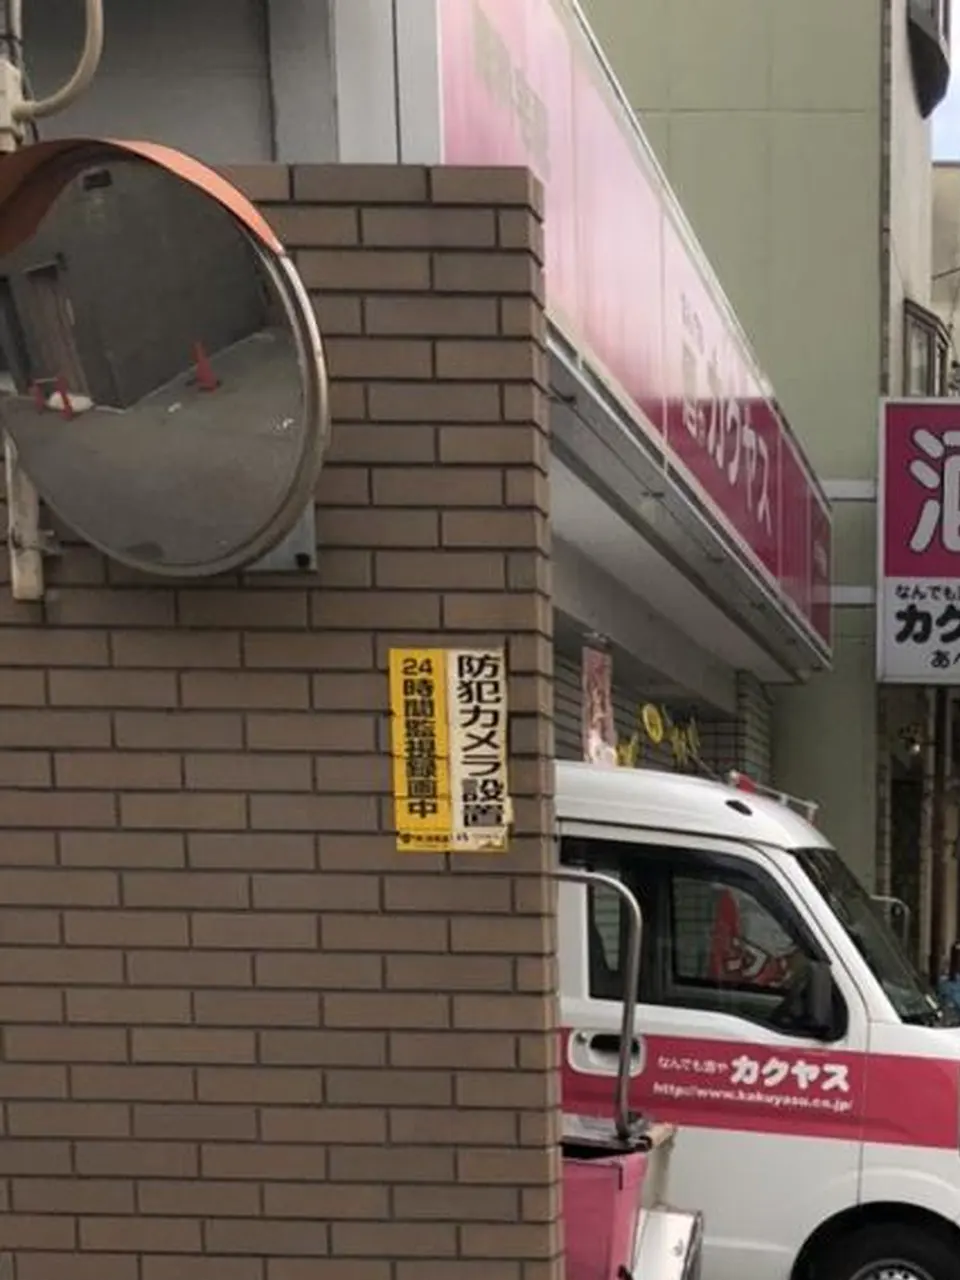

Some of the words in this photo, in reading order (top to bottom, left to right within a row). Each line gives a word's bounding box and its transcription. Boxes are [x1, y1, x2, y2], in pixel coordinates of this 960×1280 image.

[457, 654, 506, 828] 防犯カメラ設置
[730, 1054, 850, 1092] カクヤス
